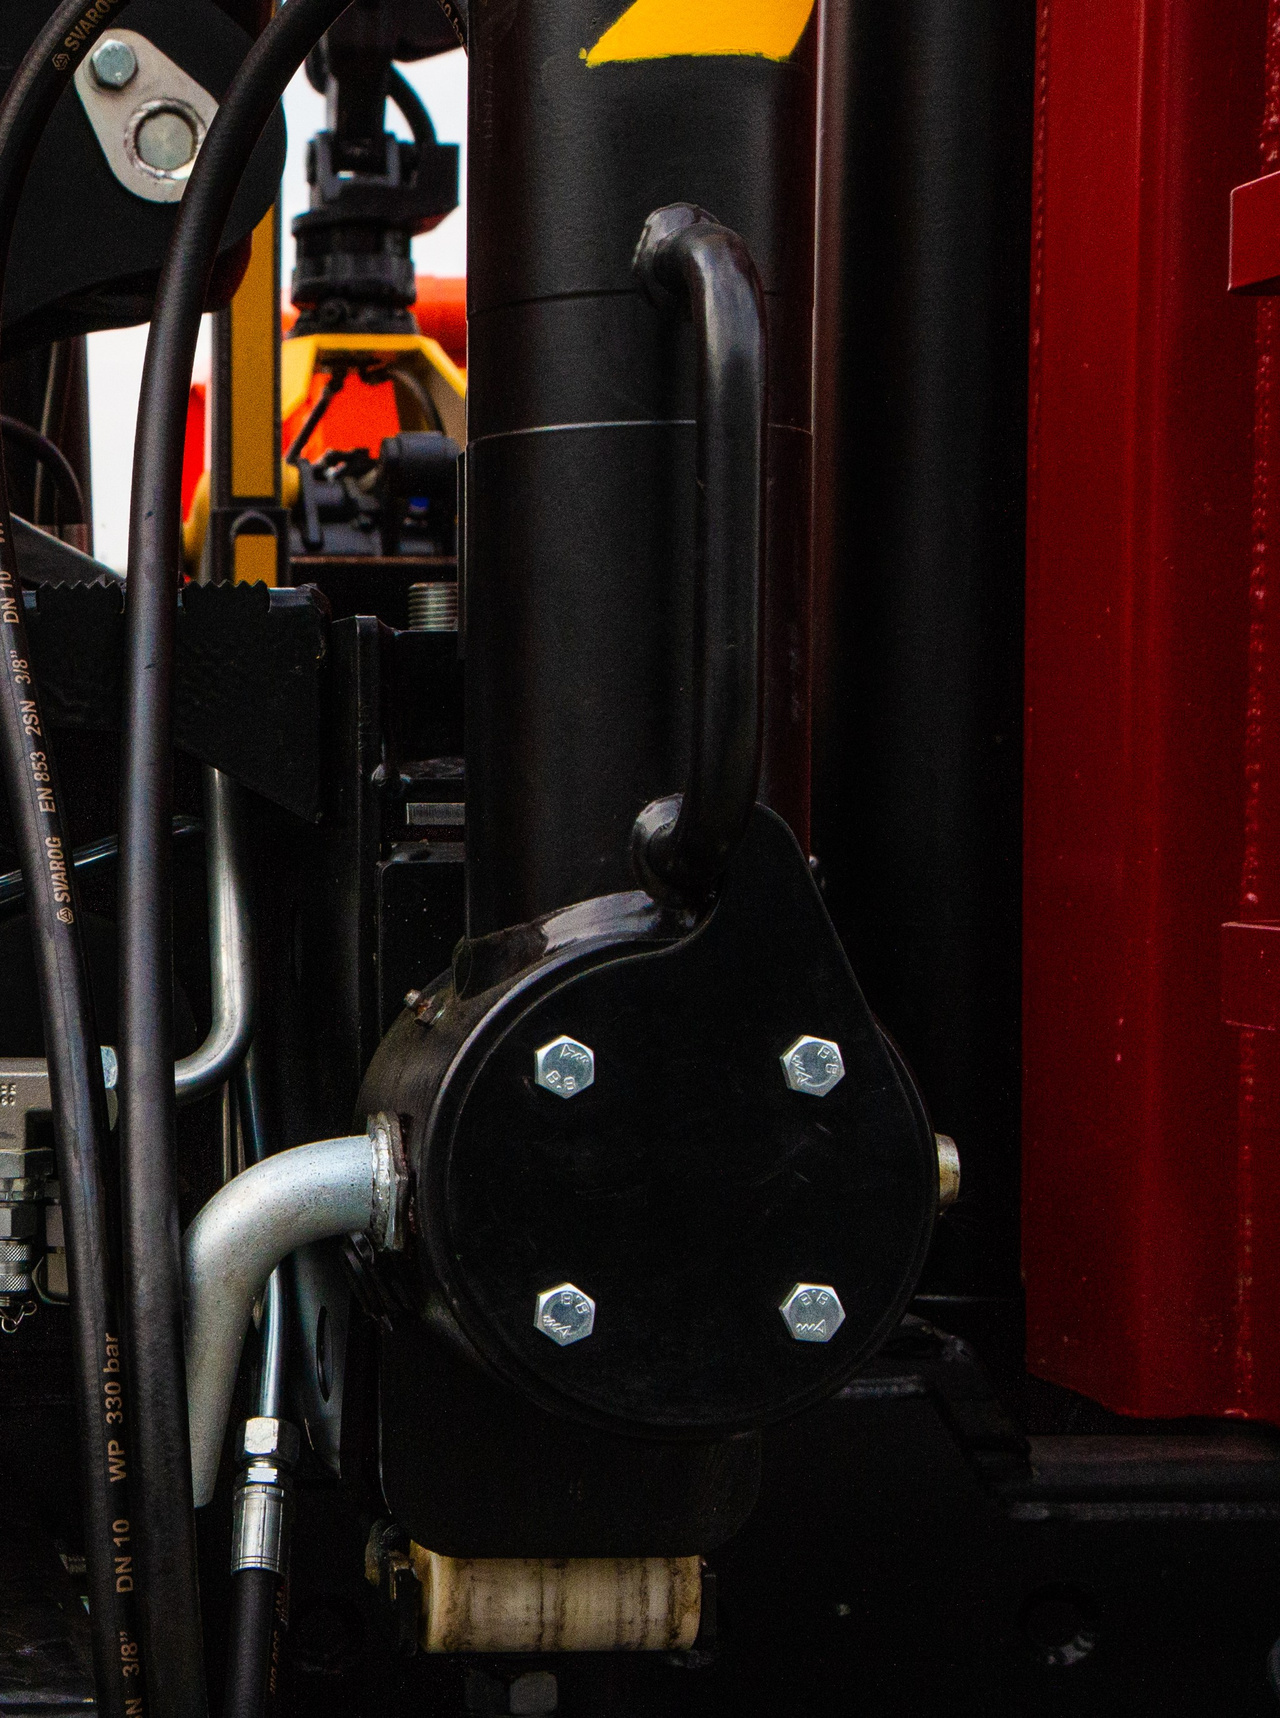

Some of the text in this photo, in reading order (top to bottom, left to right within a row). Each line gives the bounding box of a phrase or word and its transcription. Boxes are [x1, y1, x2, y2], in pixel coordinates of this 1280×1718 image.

[0, 596, 20, 624] DN
[20, 700, 41, 736] 2SN
[29, 751, 50, 782] 853
[36, 787, 56, 813] EN
[45, 836, 71, 903] SVAROG
[103, 1332, 119, 1374] bar
[105, 1381, 124, 1424] 330
[108, 1440, 127, 1483] WP
[112, 1519, 131, 1546] 10
[114, 1555, 134, 1593] DN
